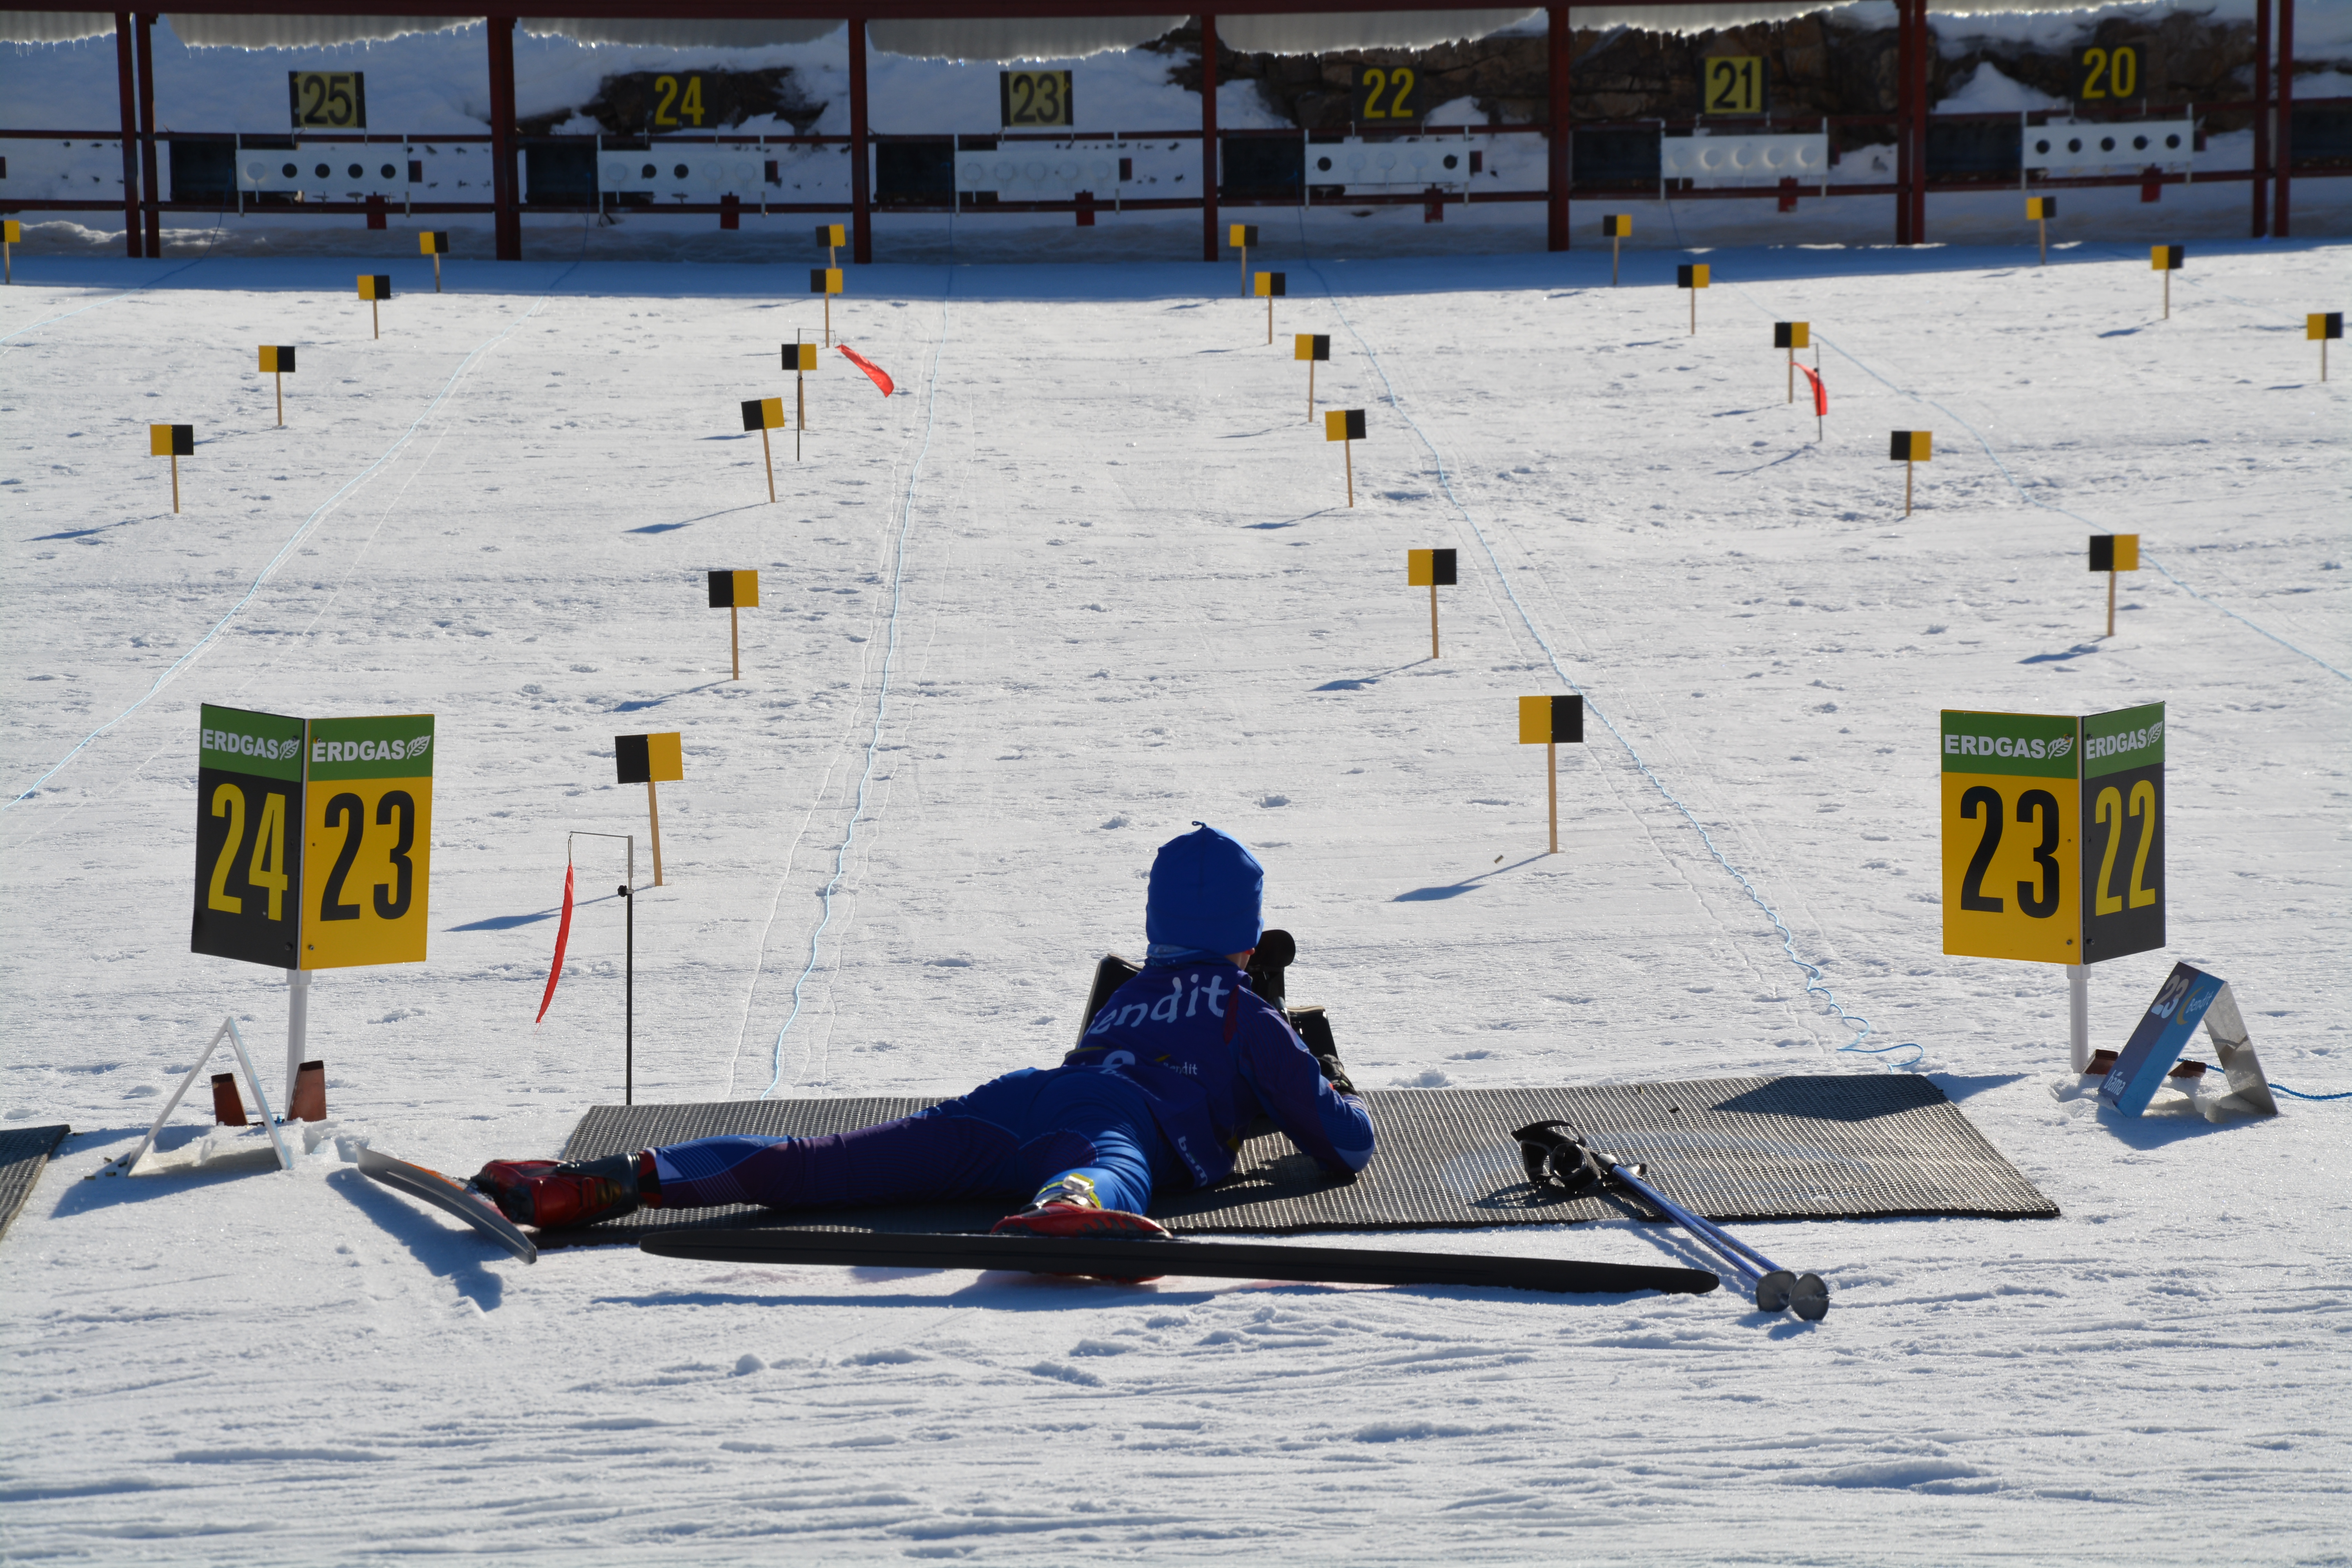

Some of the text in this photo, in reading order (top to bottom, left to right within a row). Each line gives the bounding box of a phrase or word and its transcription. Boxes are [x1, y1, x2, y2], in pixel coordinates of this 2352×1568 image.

[1013, 73, 1060, 123] 23
[1363, 68, 1415, 119] 22
[1713, 60, 1753, 109] 21
[2082, 47, 2136, 100] 20
[303, 74, 352, 125] 25
[655, 76, 705, 126] 24
[201, 728, 279, 760] ERDGAS
[312, 740, 405, 762] ERDGAS
[1945, 734, 2045, 759] ERDGAS
[2086, 729, 2146, 759] ERDGAS
[208, 783, 288, 922] 24
[320, 790, 415, 922] 23
[1960, 786, 2060, 918] 23
[2095, 780, 2156, 916] 22
[2151, 975, 2189, 1019] 23
[2185, 991, 2214, 1014] Bendit
